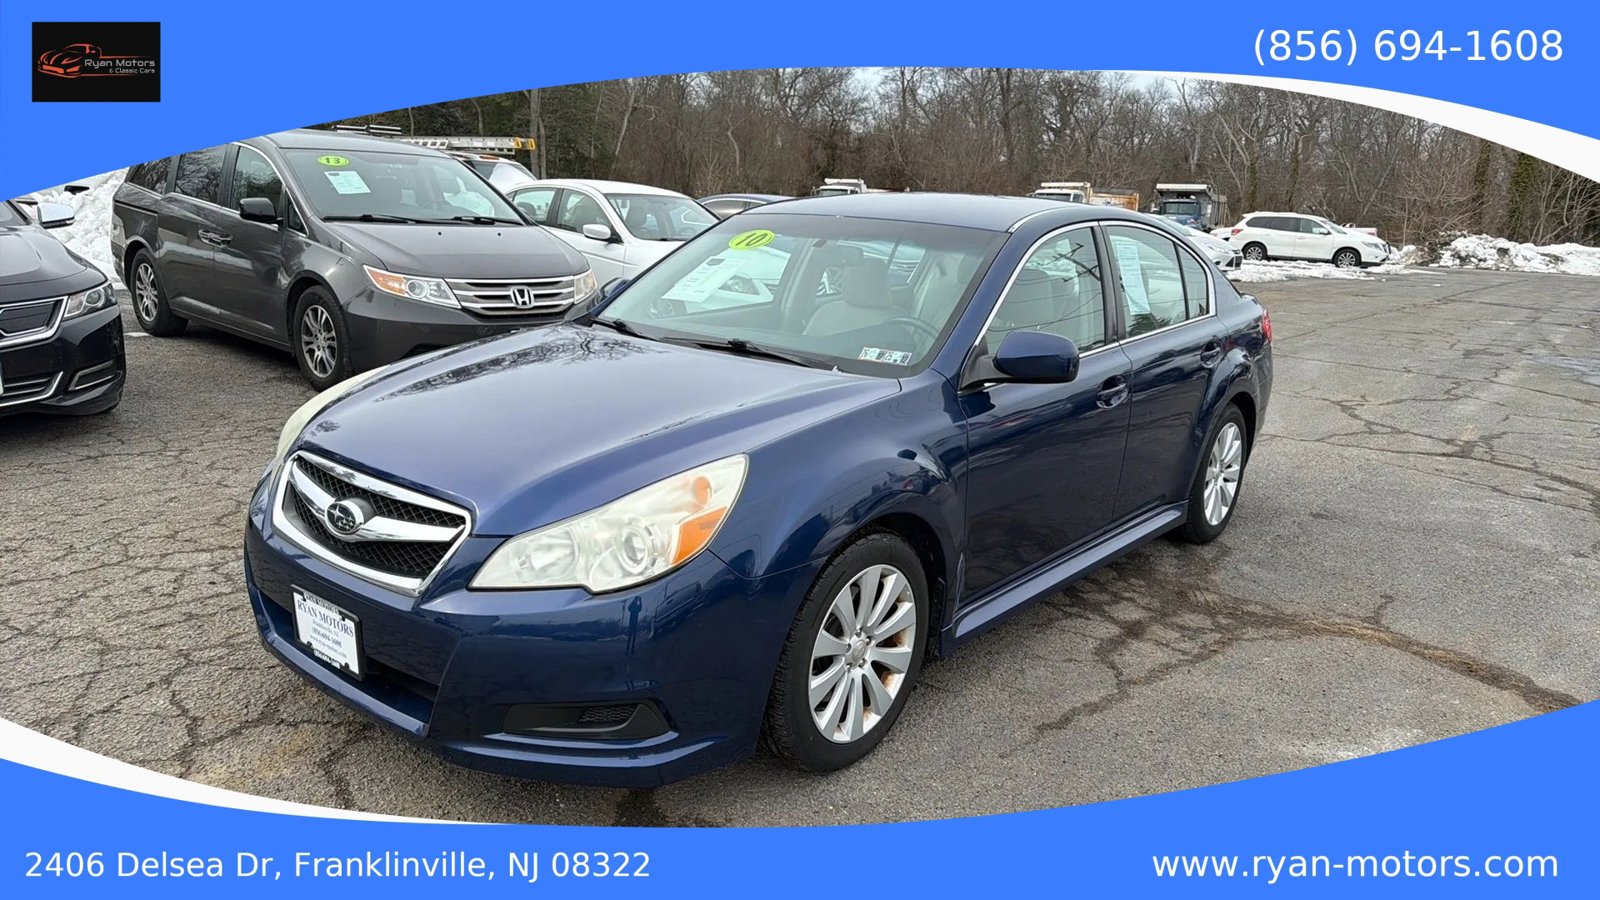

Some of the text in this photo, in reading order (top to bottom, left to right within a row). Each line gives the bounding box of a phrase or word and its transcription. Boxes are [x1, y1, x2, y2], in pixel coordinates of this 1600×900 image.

[735, 232, 769, 247] 10
[297, 600, 318, 619] RYAN
[319, 612, 354, 638] MOTORS
